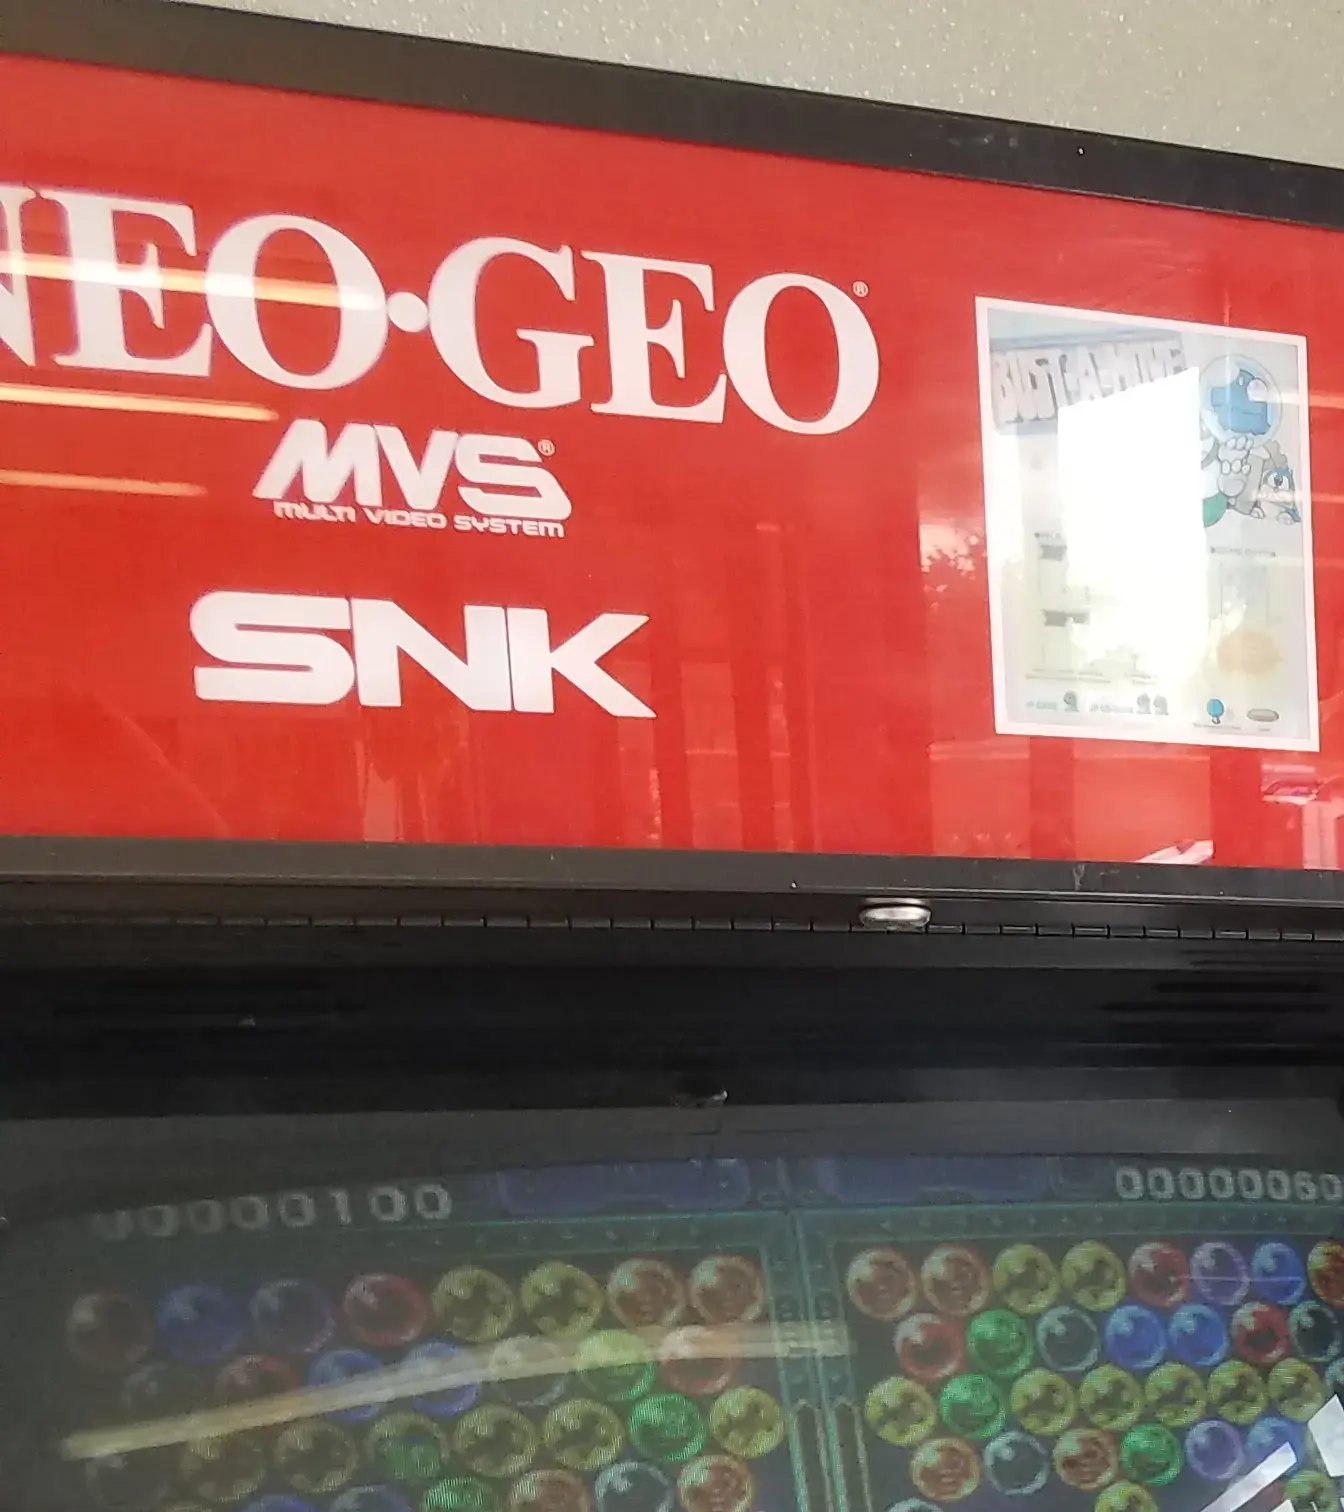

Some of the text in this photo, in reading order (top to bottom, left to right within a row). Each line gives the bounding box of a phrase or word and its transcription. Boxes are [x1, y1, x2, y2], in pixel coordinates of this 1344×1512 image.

[0, 182, 880, 436] EO·GEO
[252, 418, 573, 522] MVS
[273, 500, 565, 539] MULTI VIDEO SYSTEM
[190, 589, 657, 720] SNK
[94, 1183, 453, 1241] 00000100
[1115, 1165, 1343, 1202] 00000060
